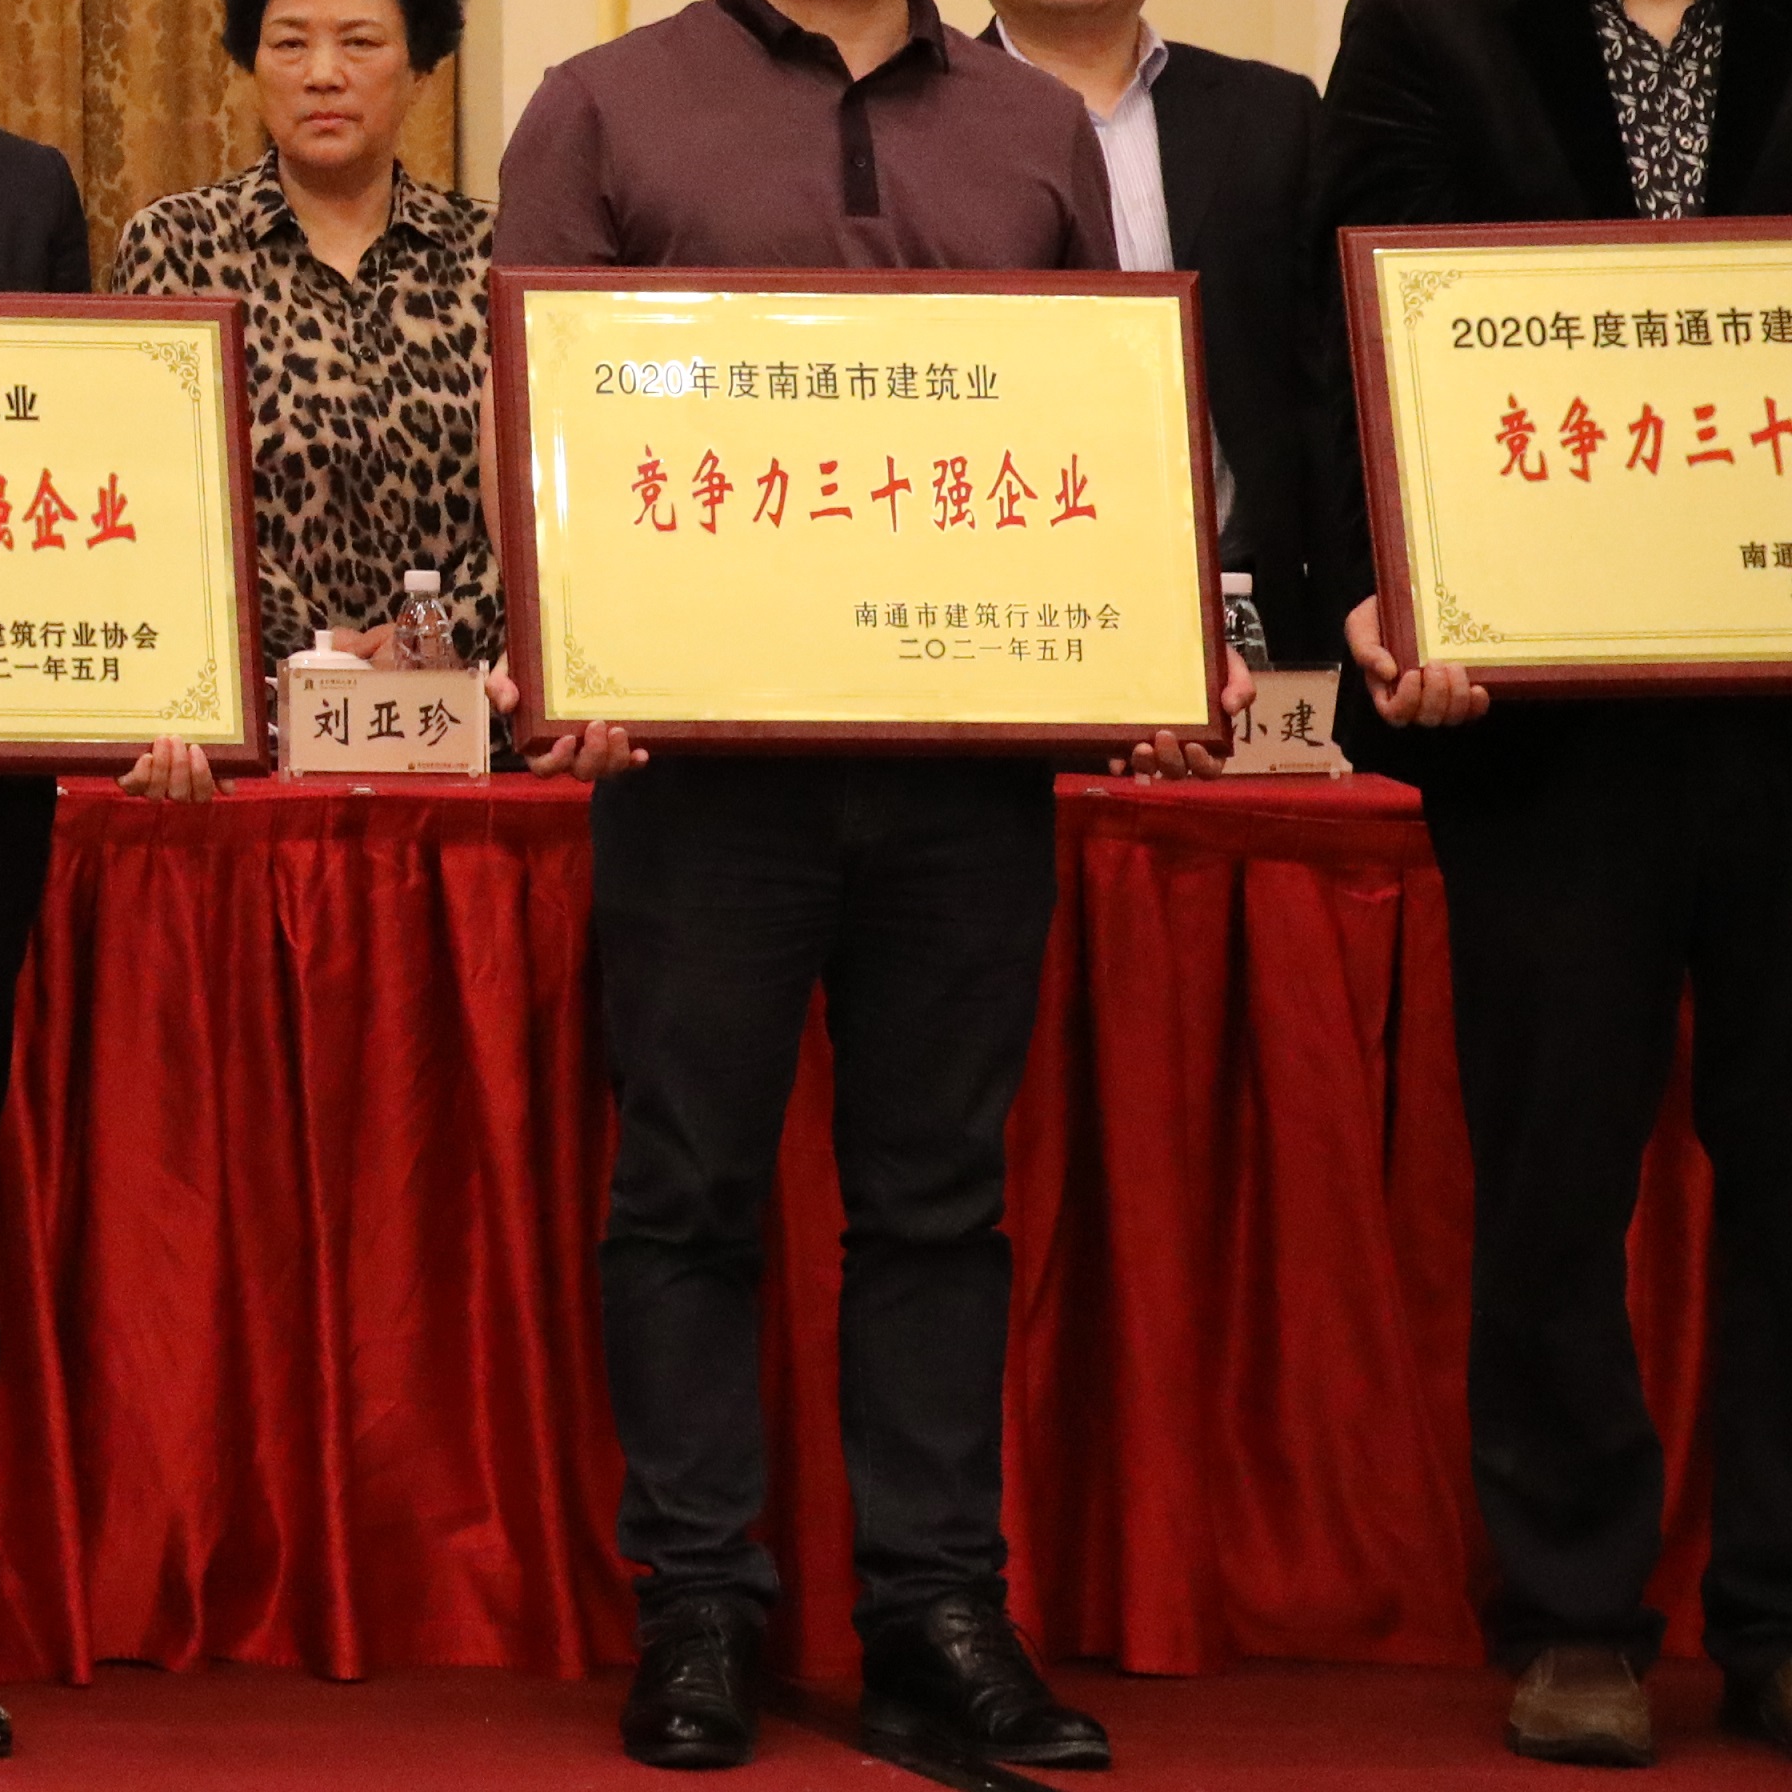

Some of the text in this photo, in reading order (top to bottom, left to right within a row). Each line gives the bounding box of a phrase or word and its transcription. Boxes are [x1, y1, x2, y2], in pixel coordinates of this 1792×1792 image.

[596, 361, 999, 400] 2020年度南通市建筑业
[1497, 396, 1792, 482] 竞争力三十
[632, 448, 1096, 534] 竞争力三十强企业
[856, 602, 1120, 629] 南通市建筑行业协会
[314, 698, 461, 746] 刘亚珍
